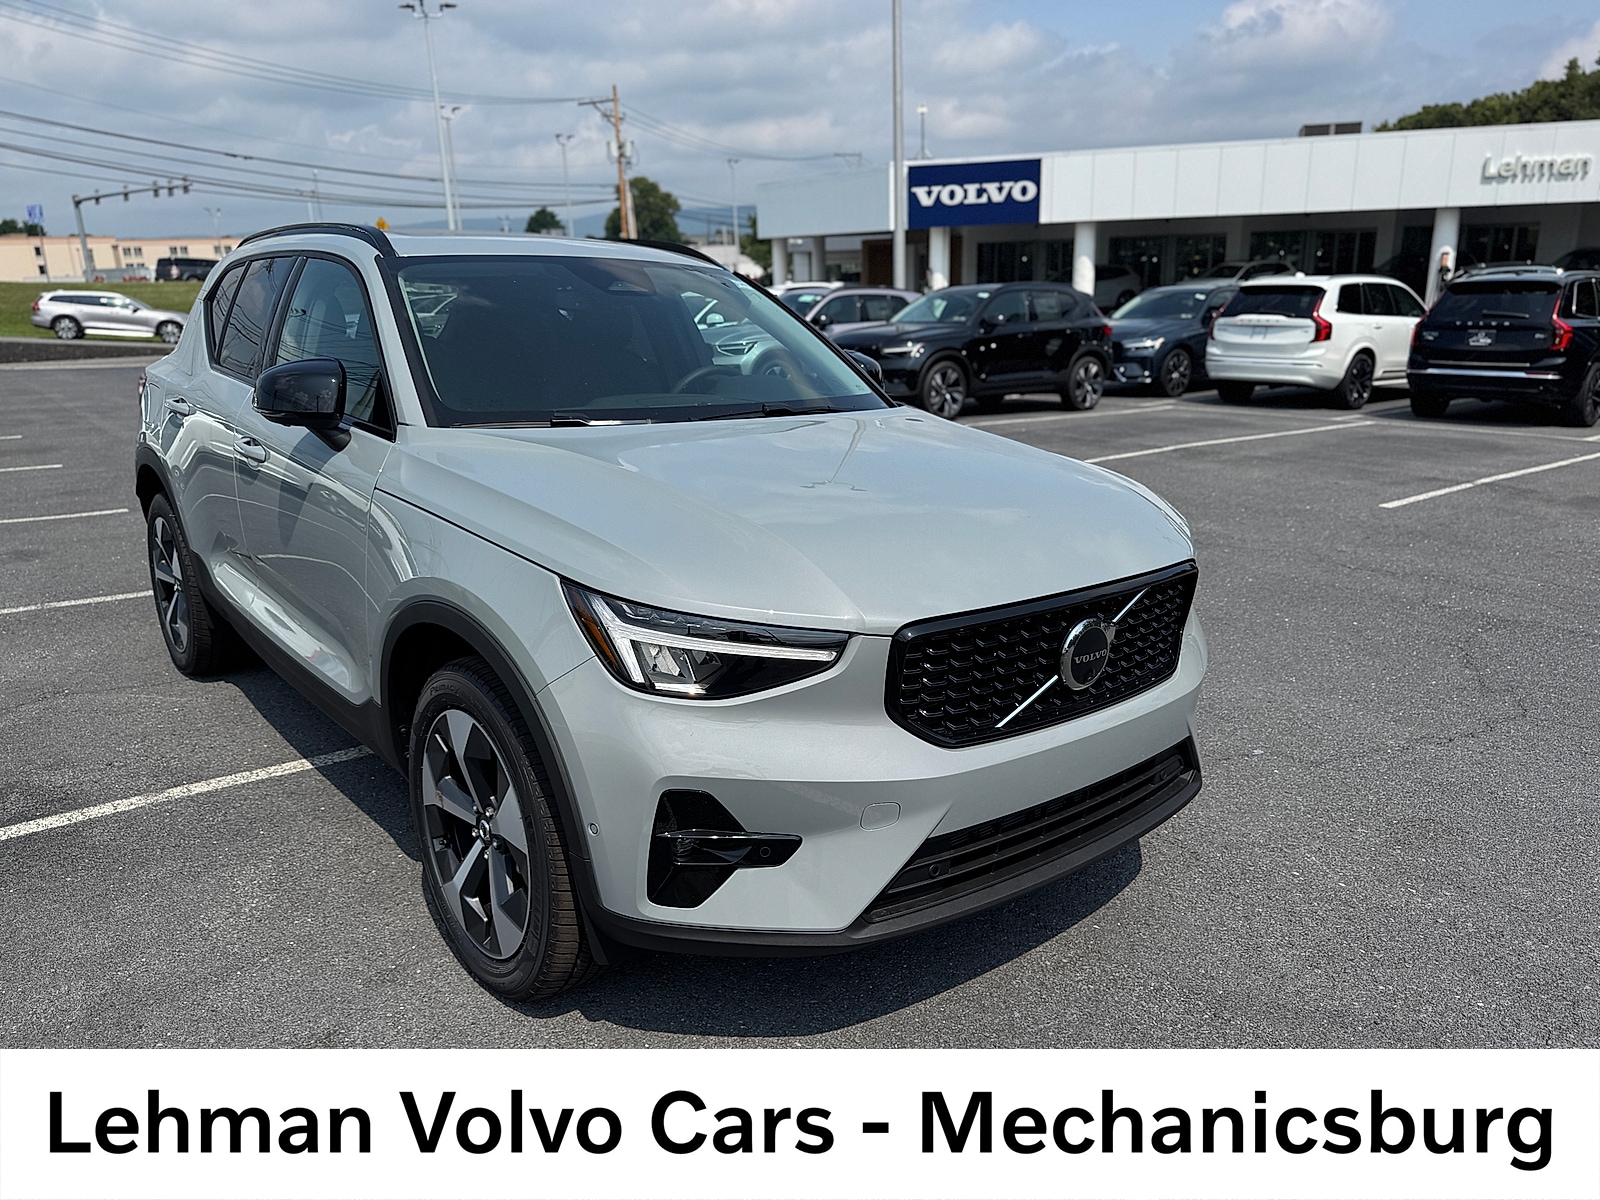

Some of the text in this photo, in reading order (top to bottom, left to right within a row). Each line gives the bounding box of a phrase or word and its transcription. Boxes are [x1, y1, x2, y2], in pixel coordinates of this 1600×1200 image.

[1481, 155, 1592, 183] Lehman
[910, 180, 1038, 207] VOLVO
[1073, 648, 1107, 664] VOLVO
